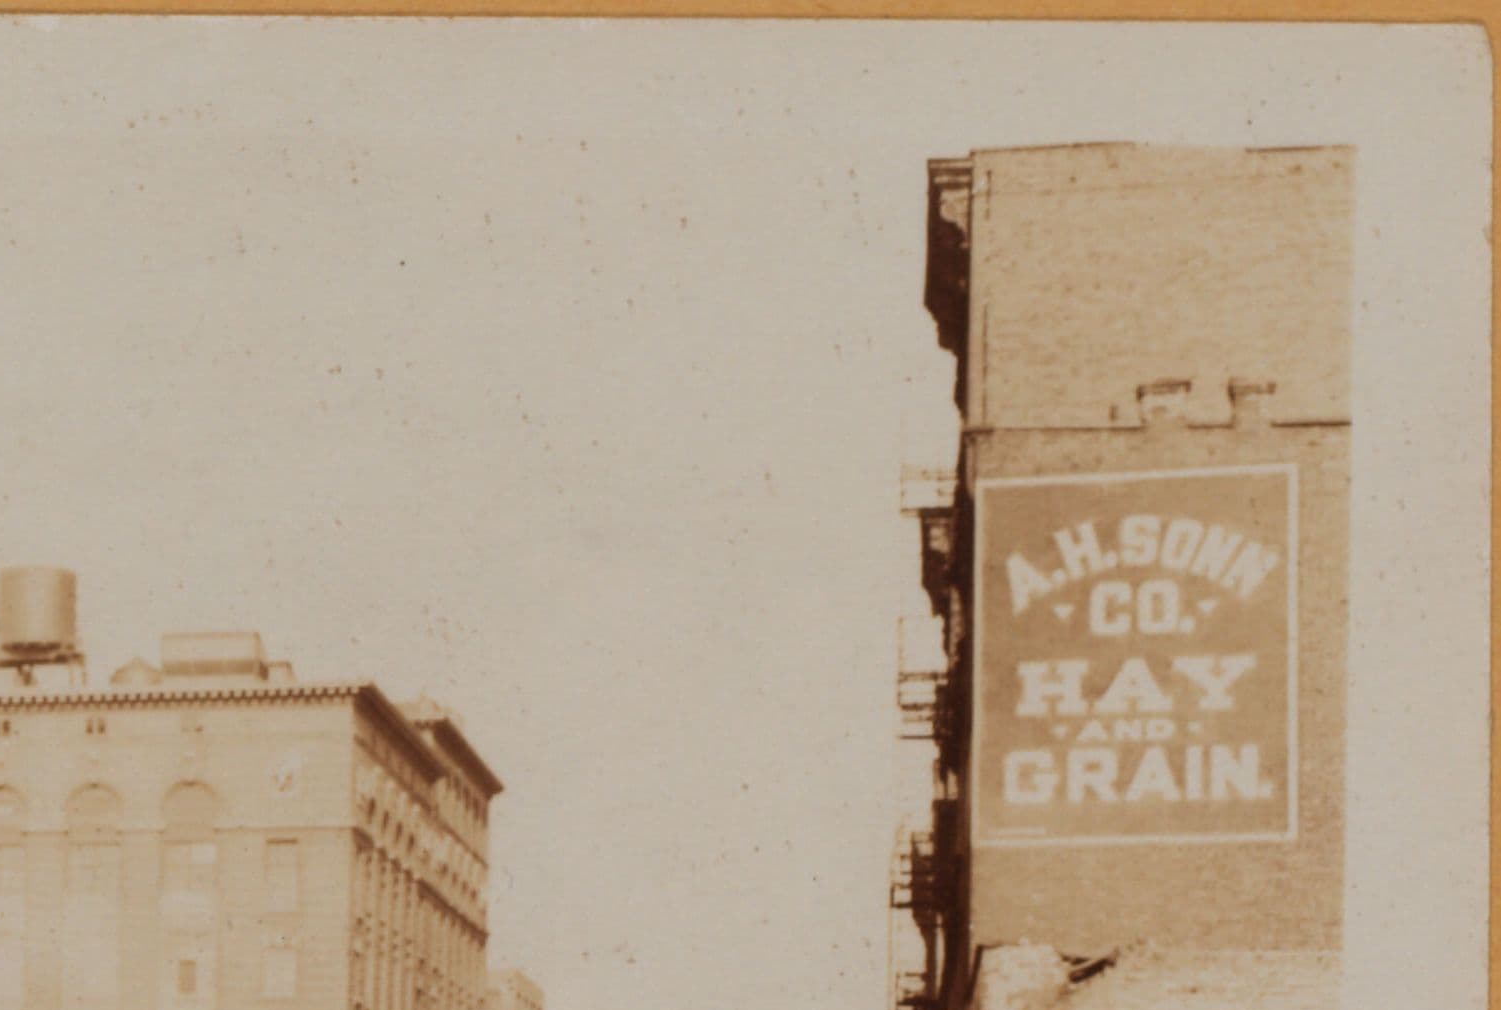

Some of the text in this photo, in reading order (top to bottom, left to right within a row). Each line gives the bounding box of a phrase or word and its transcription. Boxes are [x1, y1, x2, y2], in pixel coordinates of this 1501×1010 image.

[1089, 578, 1196, 637] CO.
[1014, 653, 1257, 718] HAY
[1076, 718, 1176, 742] AND
[1003, 743, 1275, 804] GRAIN.
